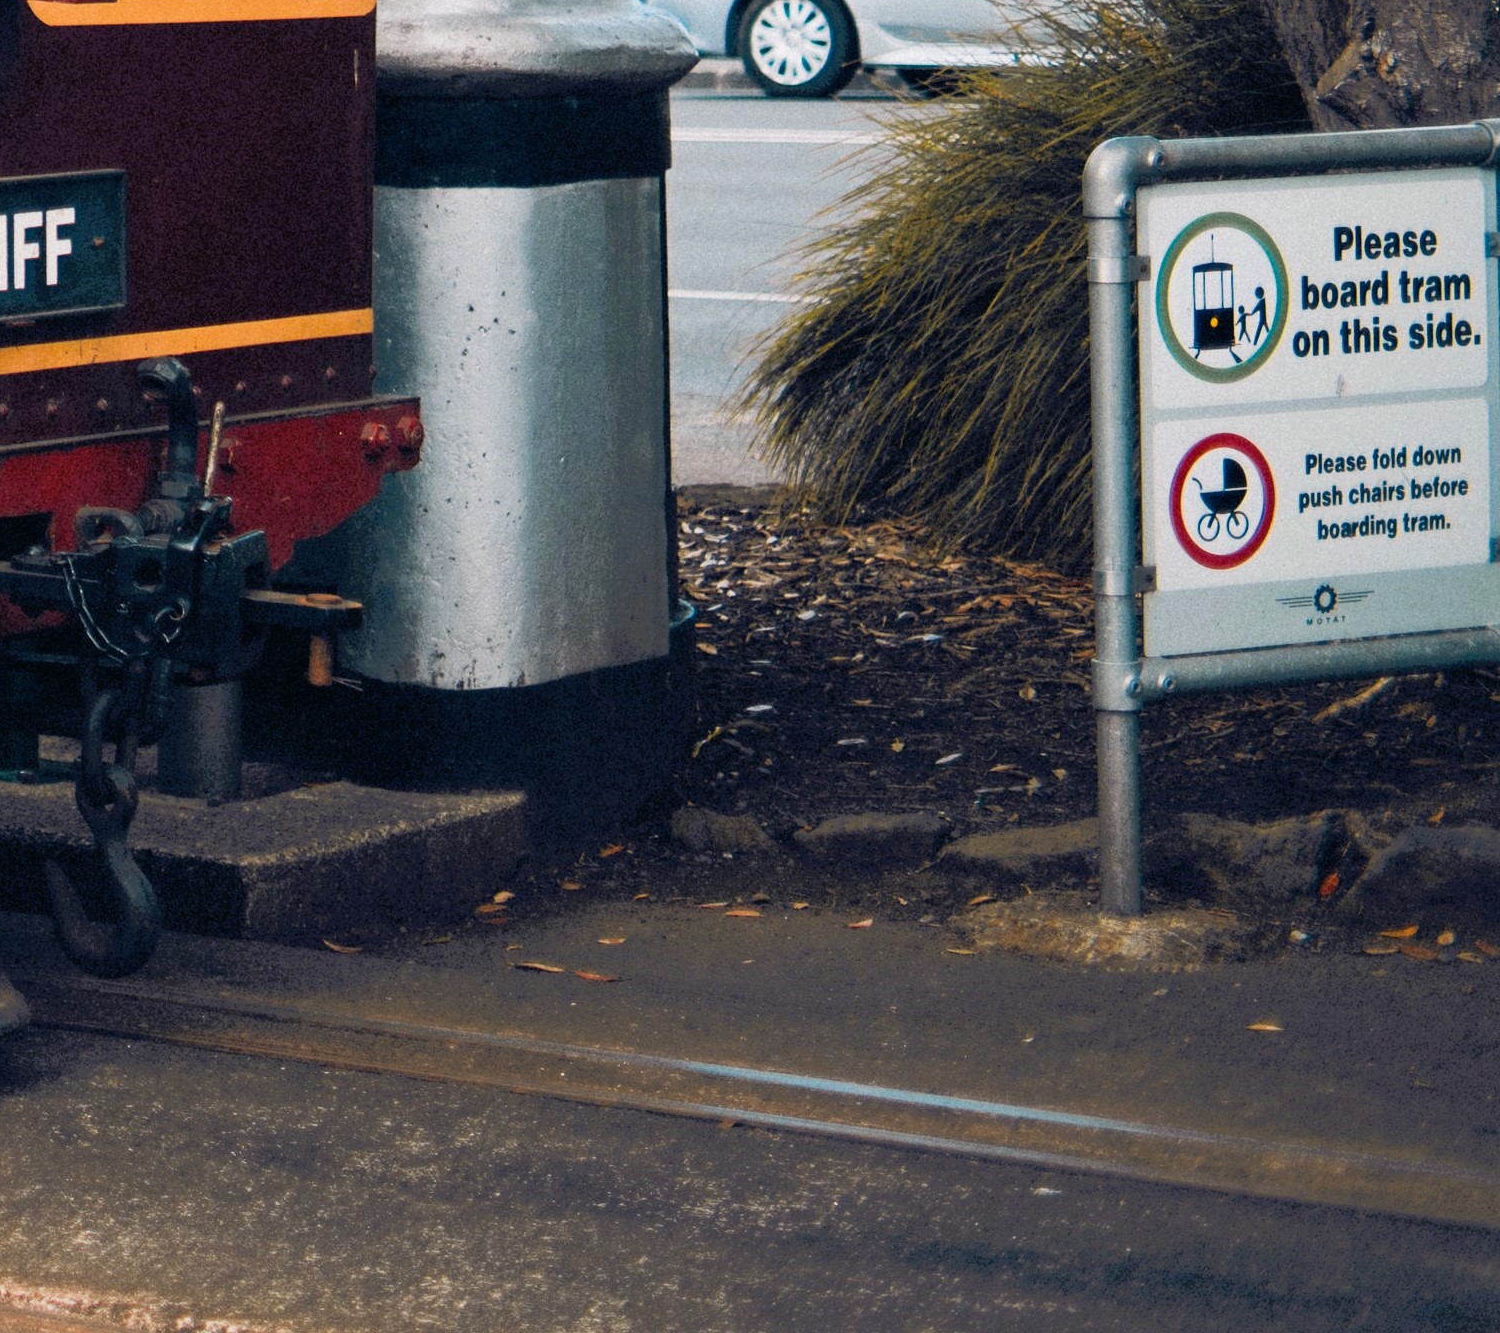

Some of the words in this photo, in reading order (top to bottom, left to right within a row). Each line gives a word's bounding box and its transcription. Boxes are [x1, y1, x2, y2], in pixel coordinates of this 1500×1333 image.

[1333, 225, 1438, 262] Please
[1301, 270, 1389, 310] board
[1399, 270, 1471, 304] tram
[1292, 330, 1330, 358] on
[1340, 316, 1398, 354] this
[1408, 312, 1481, 350] side.
[1305, 453, 1367, 475] Please
[1372, 446, 1407, 470] fold
[1412, 445, 1461, 467] down
[1299, 485, 1343, 513] push
[1349, 480, 1405, 505] chairs
[1410, 476, 1469, 500] before
[1317, 514, 1397, 541] boarding
[1403, 512, 1451, 533] tram.
[1306, 615, 1346, 626] MOTAT
